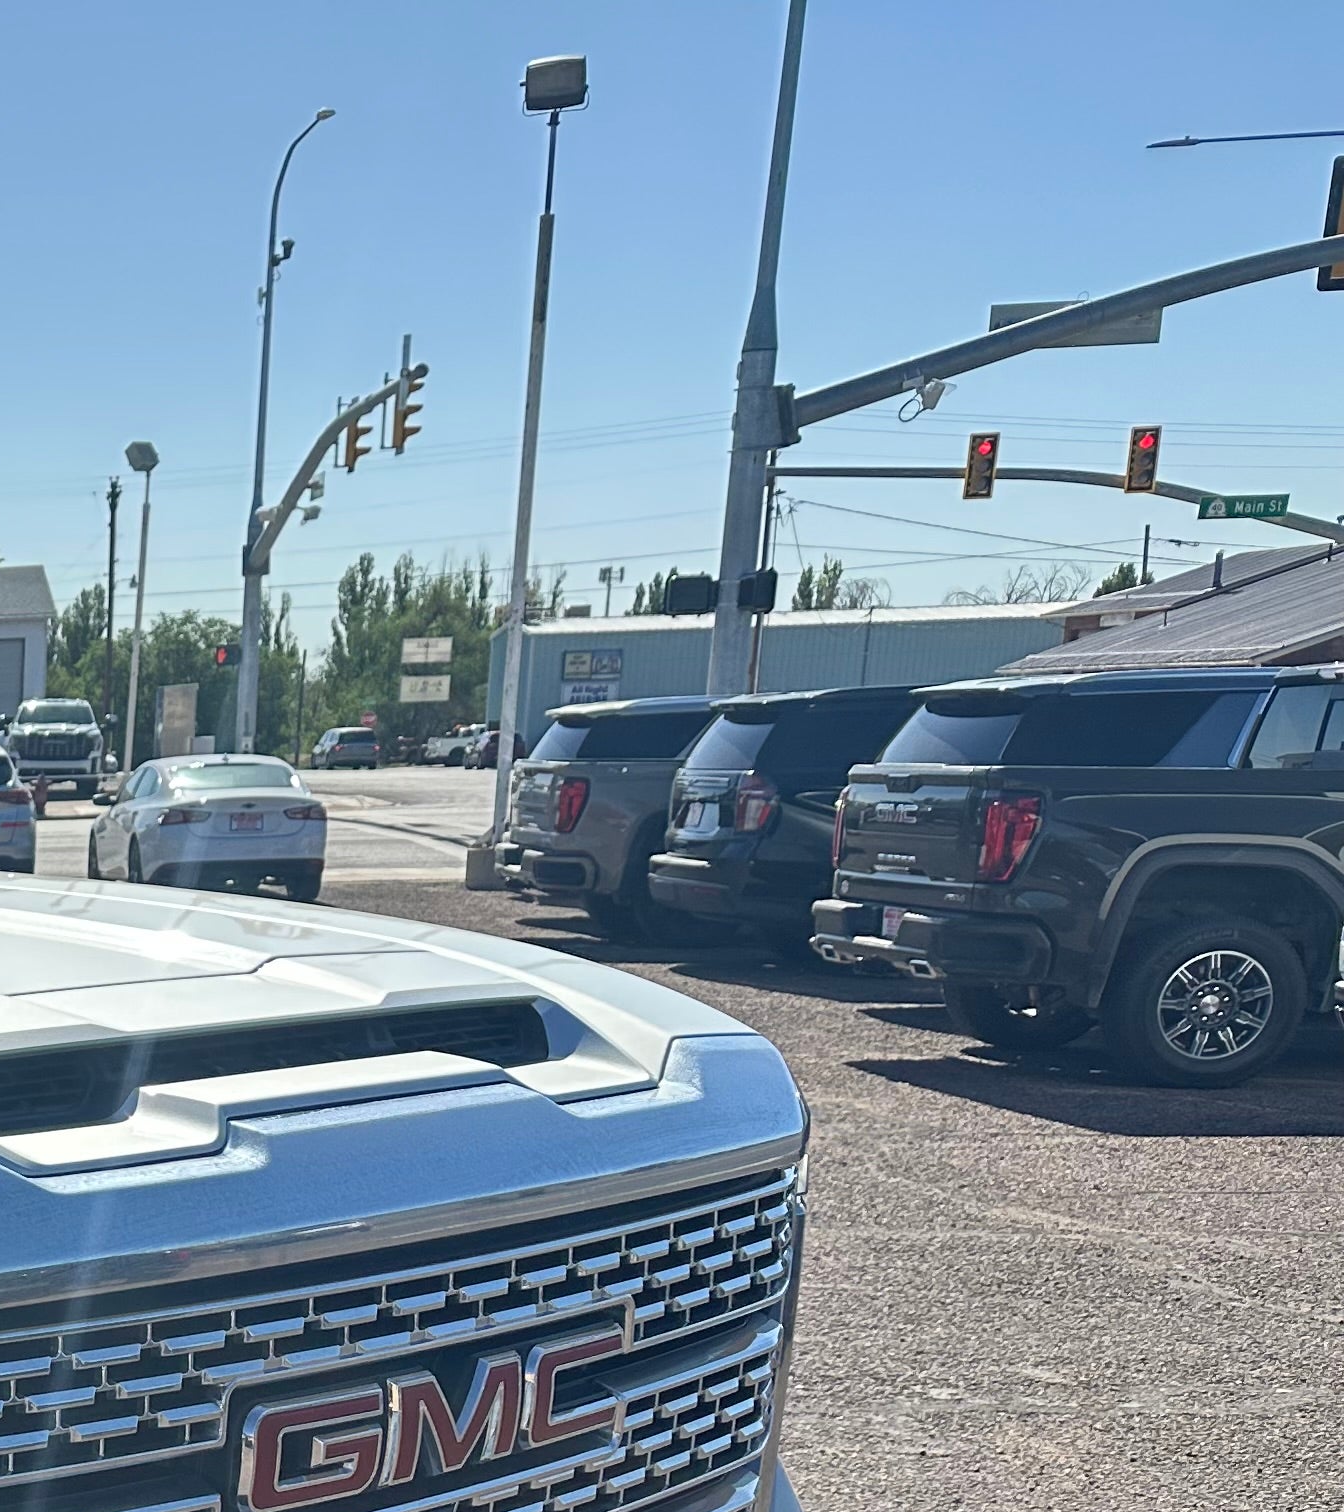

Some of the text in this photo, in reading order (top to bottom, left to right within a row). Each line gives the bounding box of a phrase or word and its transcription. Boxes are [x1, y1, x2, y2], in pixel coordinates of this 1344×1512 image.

[1234, 500, 1282, 514] Main St
[875, 802, 918, 824] GMC
